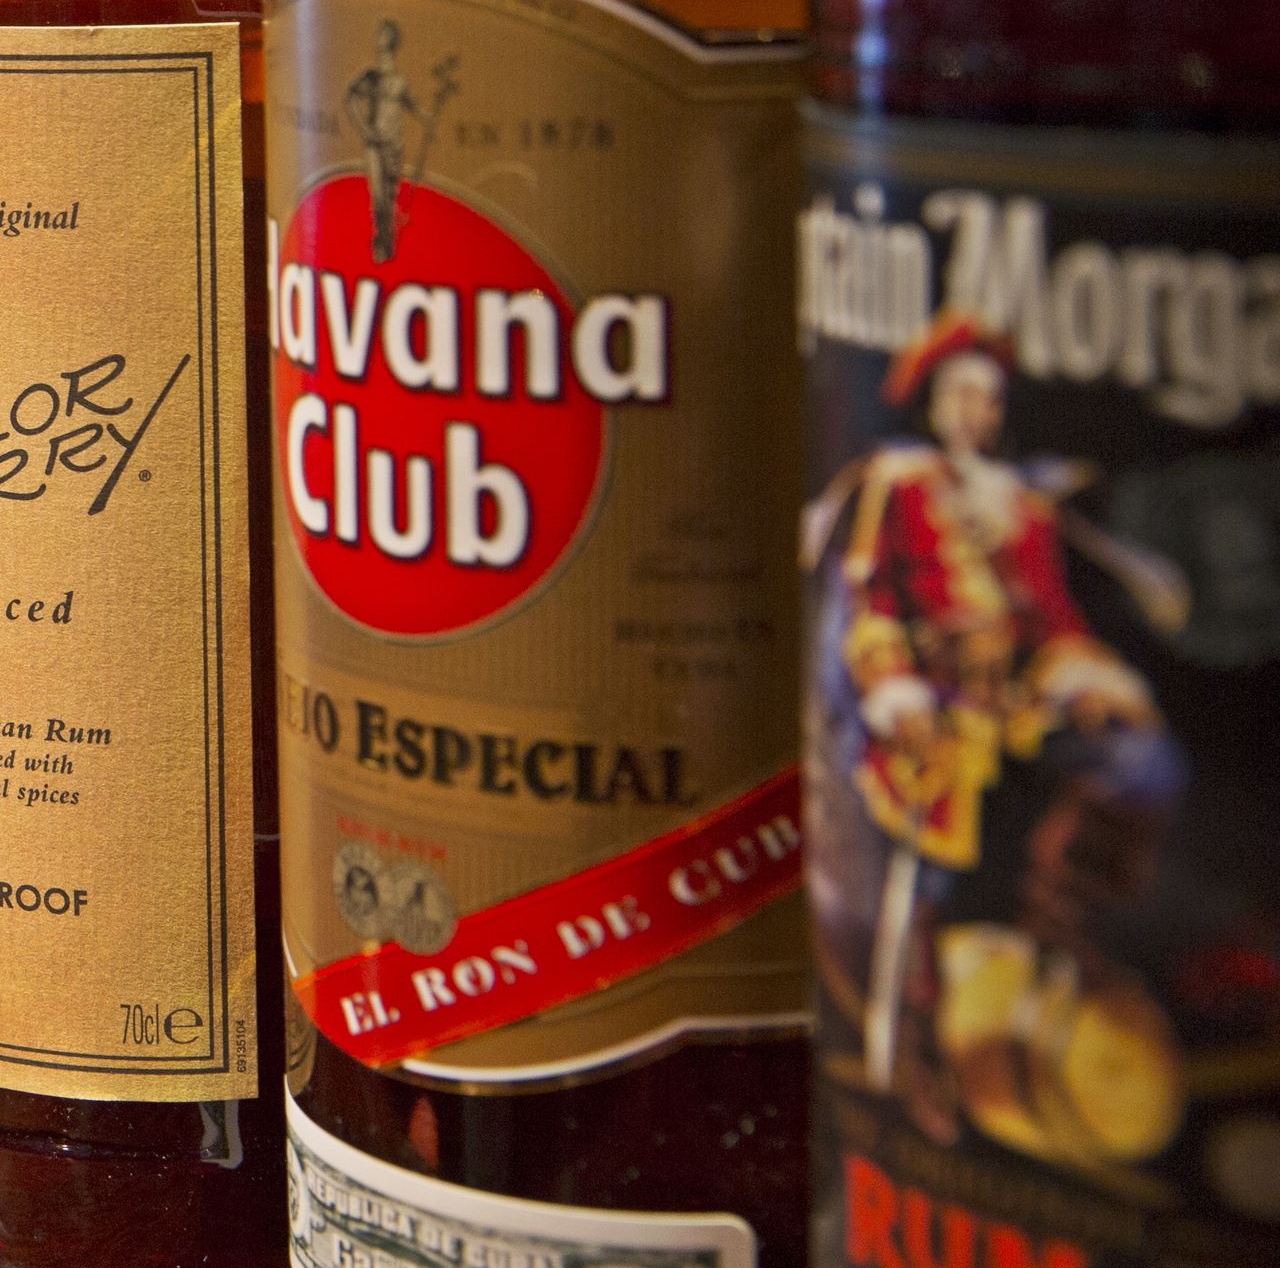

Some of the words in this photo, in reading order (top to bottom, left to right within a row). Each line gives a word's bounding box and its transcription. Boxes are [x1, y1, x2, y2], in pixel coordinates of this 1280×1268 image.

[286, 392, 532, 570] Club
[43, 717, 113, 746] Rum
[23, 749, 75, 776] with
[354, 698, 702, 810] ESPECIAL
[17, 781, 81, 807] spices
[339, 991, 401, 1037] EL
[411, 938, 538, 1013] RON
[555, 894, 652, 961] DE
[119, 1003, 160, 1045] 70cl
